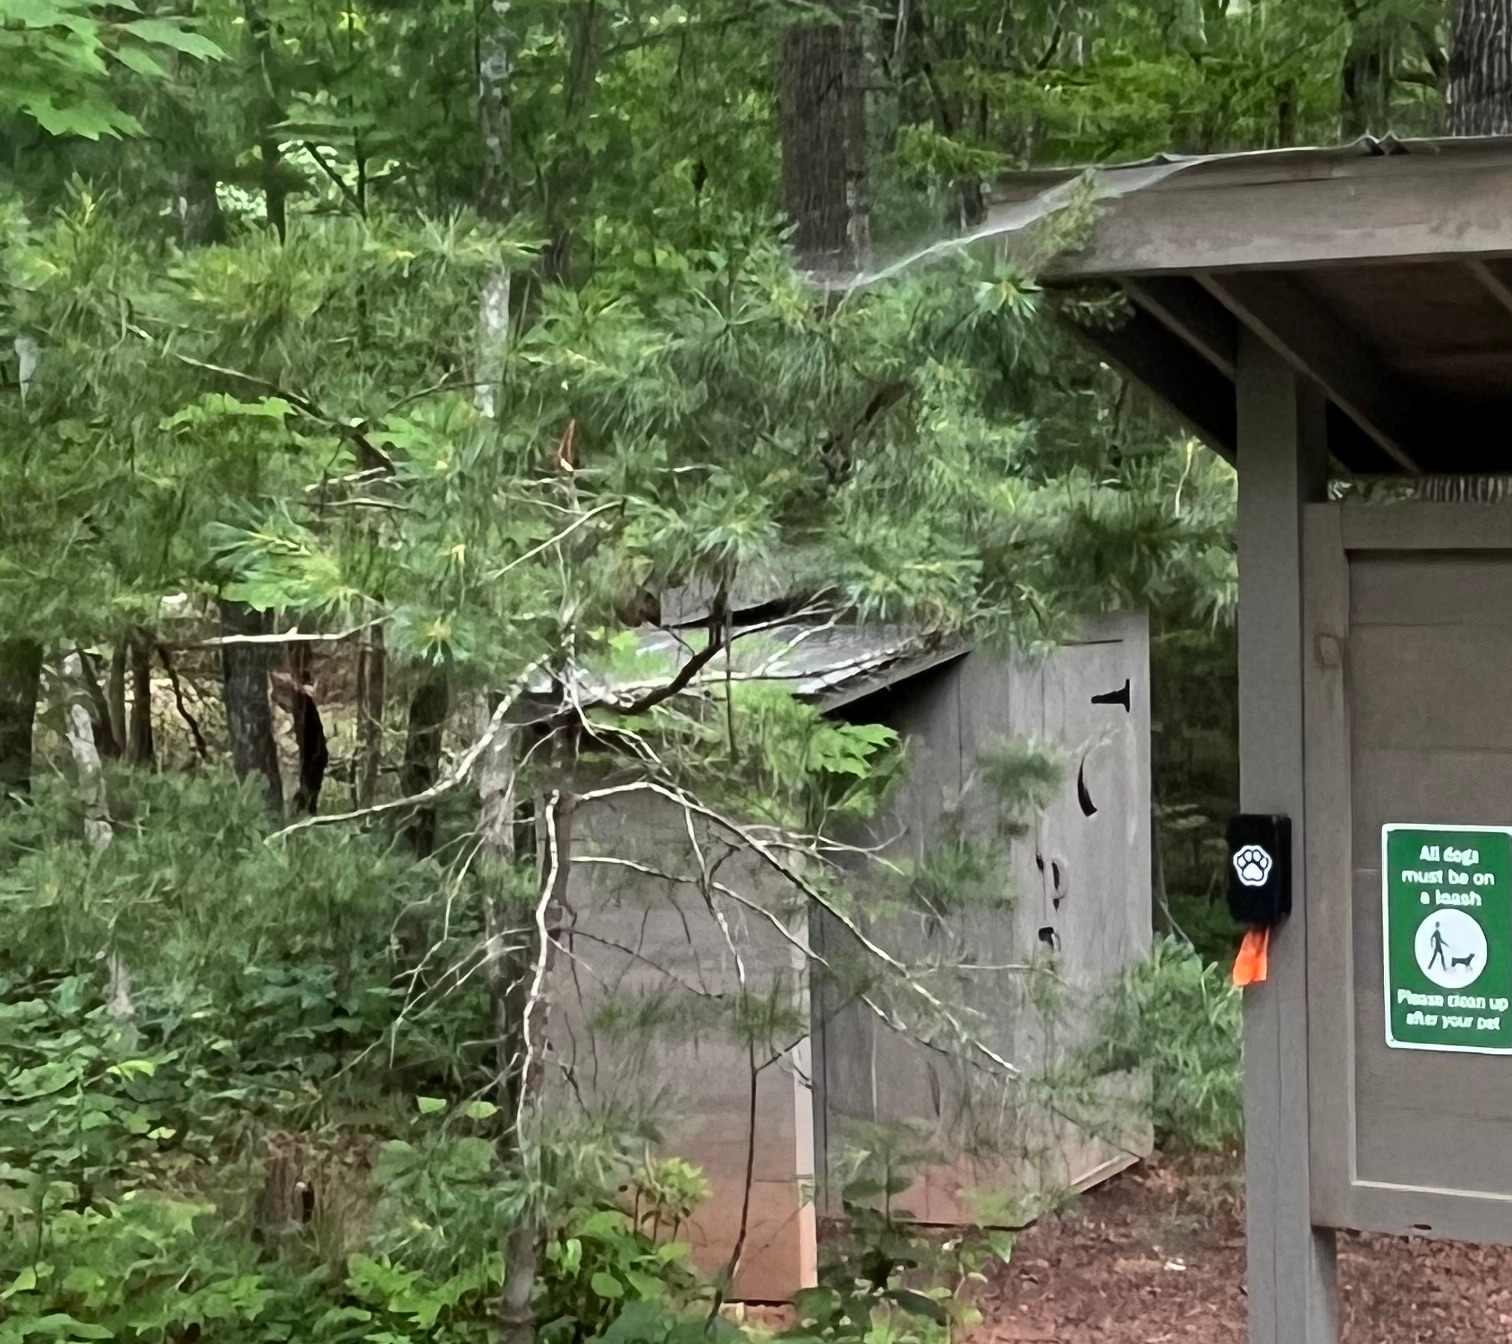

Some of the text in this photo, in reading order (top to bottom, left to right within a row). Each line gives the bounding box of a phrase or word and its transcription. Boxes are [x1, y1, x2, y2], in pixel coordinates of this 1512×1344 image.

[1419, 845, 1480, 867] All dogs
[1401, 868, 1495, 886] must be on
[1420, 889, 1482, 906] a leash
[1397, 988, 1509, 1012] Please clean up
[1406, 1010, 1501, 1031] after your pet
